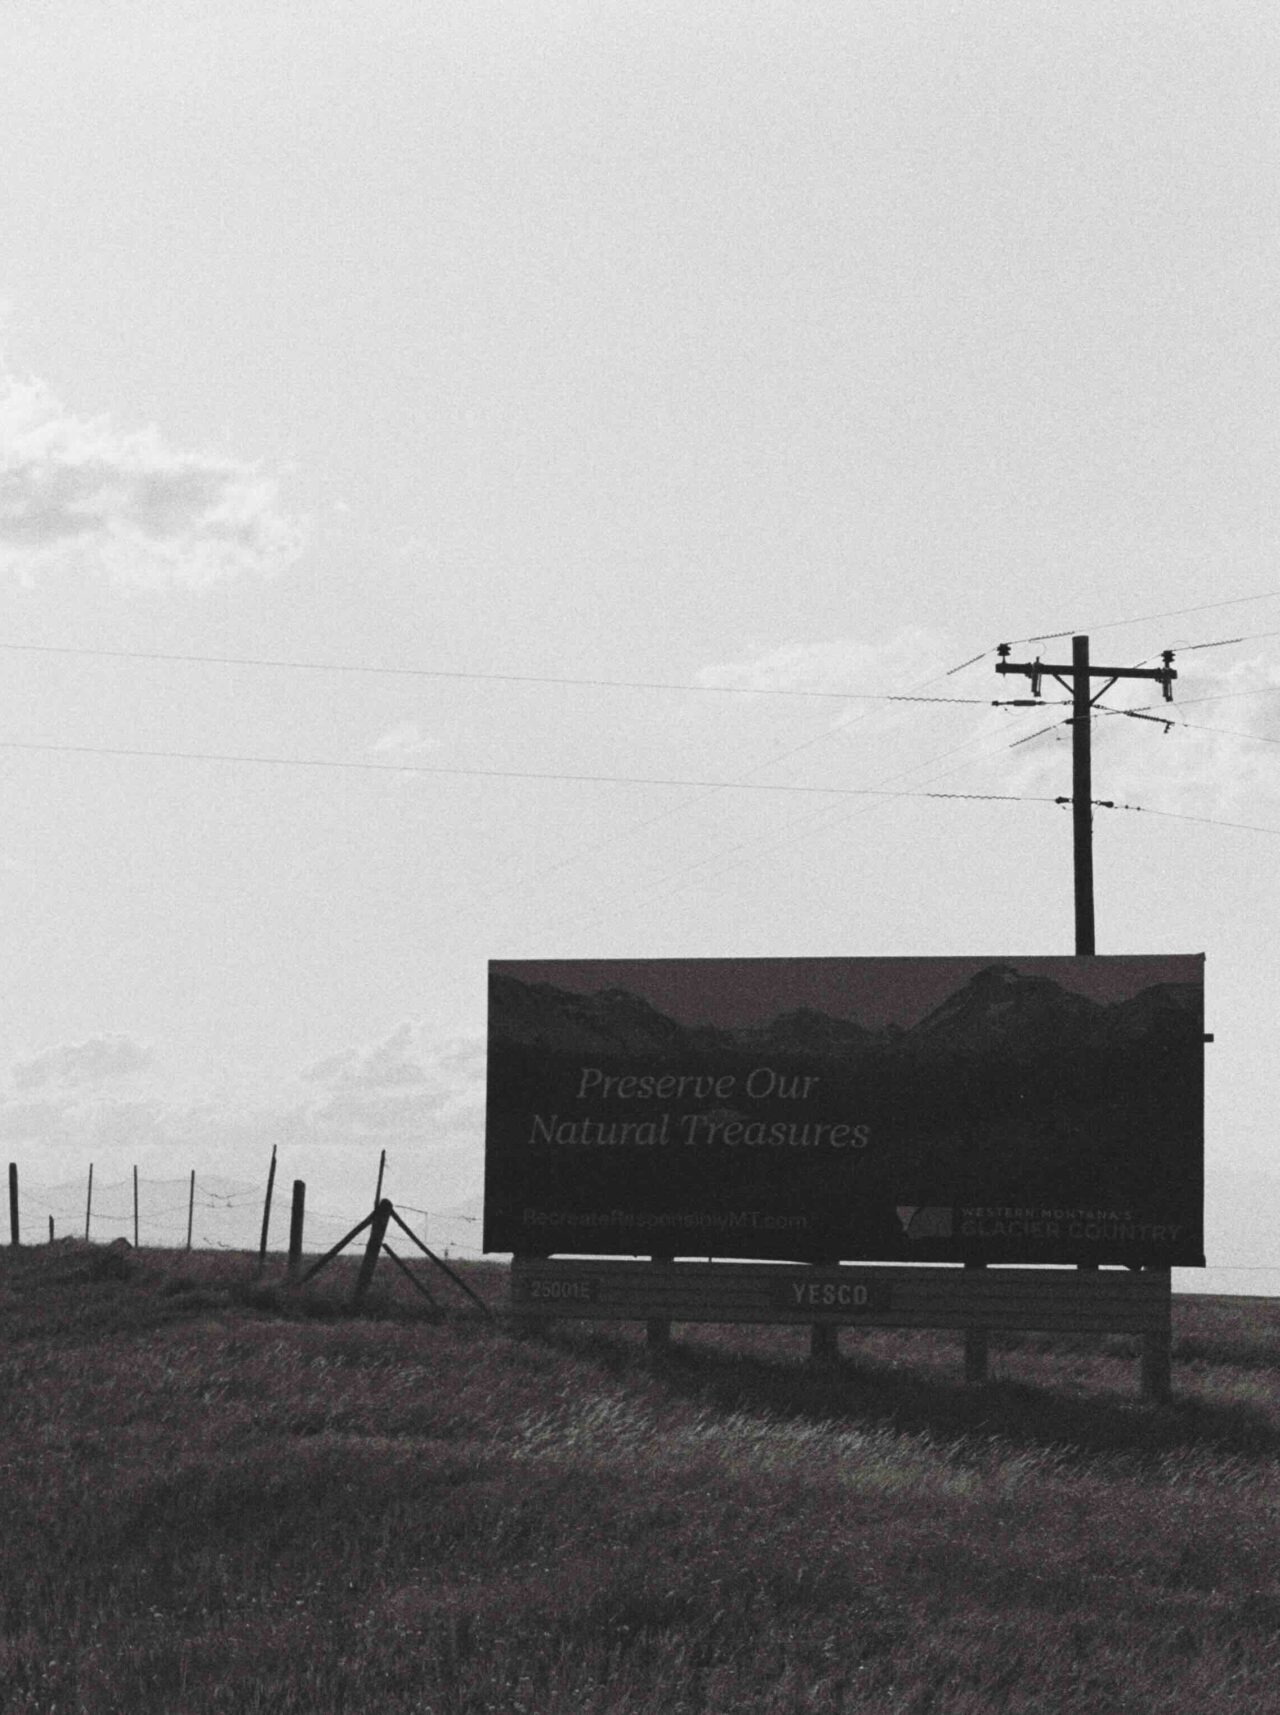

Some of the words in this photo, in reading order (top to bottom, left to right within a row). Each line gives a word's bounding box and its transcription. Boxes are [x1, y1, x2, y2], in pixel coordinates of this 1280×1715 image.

[576, 1066, 735, 1101] Preserve
[746, 1067, 819, 1100] Our
[528, 1113, 670, 1147] Natural
[680, 1114, 870, 1149] Treasures
[961, 1207, 1034, 1218] WESTERN
[961, 1220, 1061, 1238] GLACIER
[1069, 1222, 1182, 1241] COUNTRY
[791, 1282, 868, 1306] YESCO
